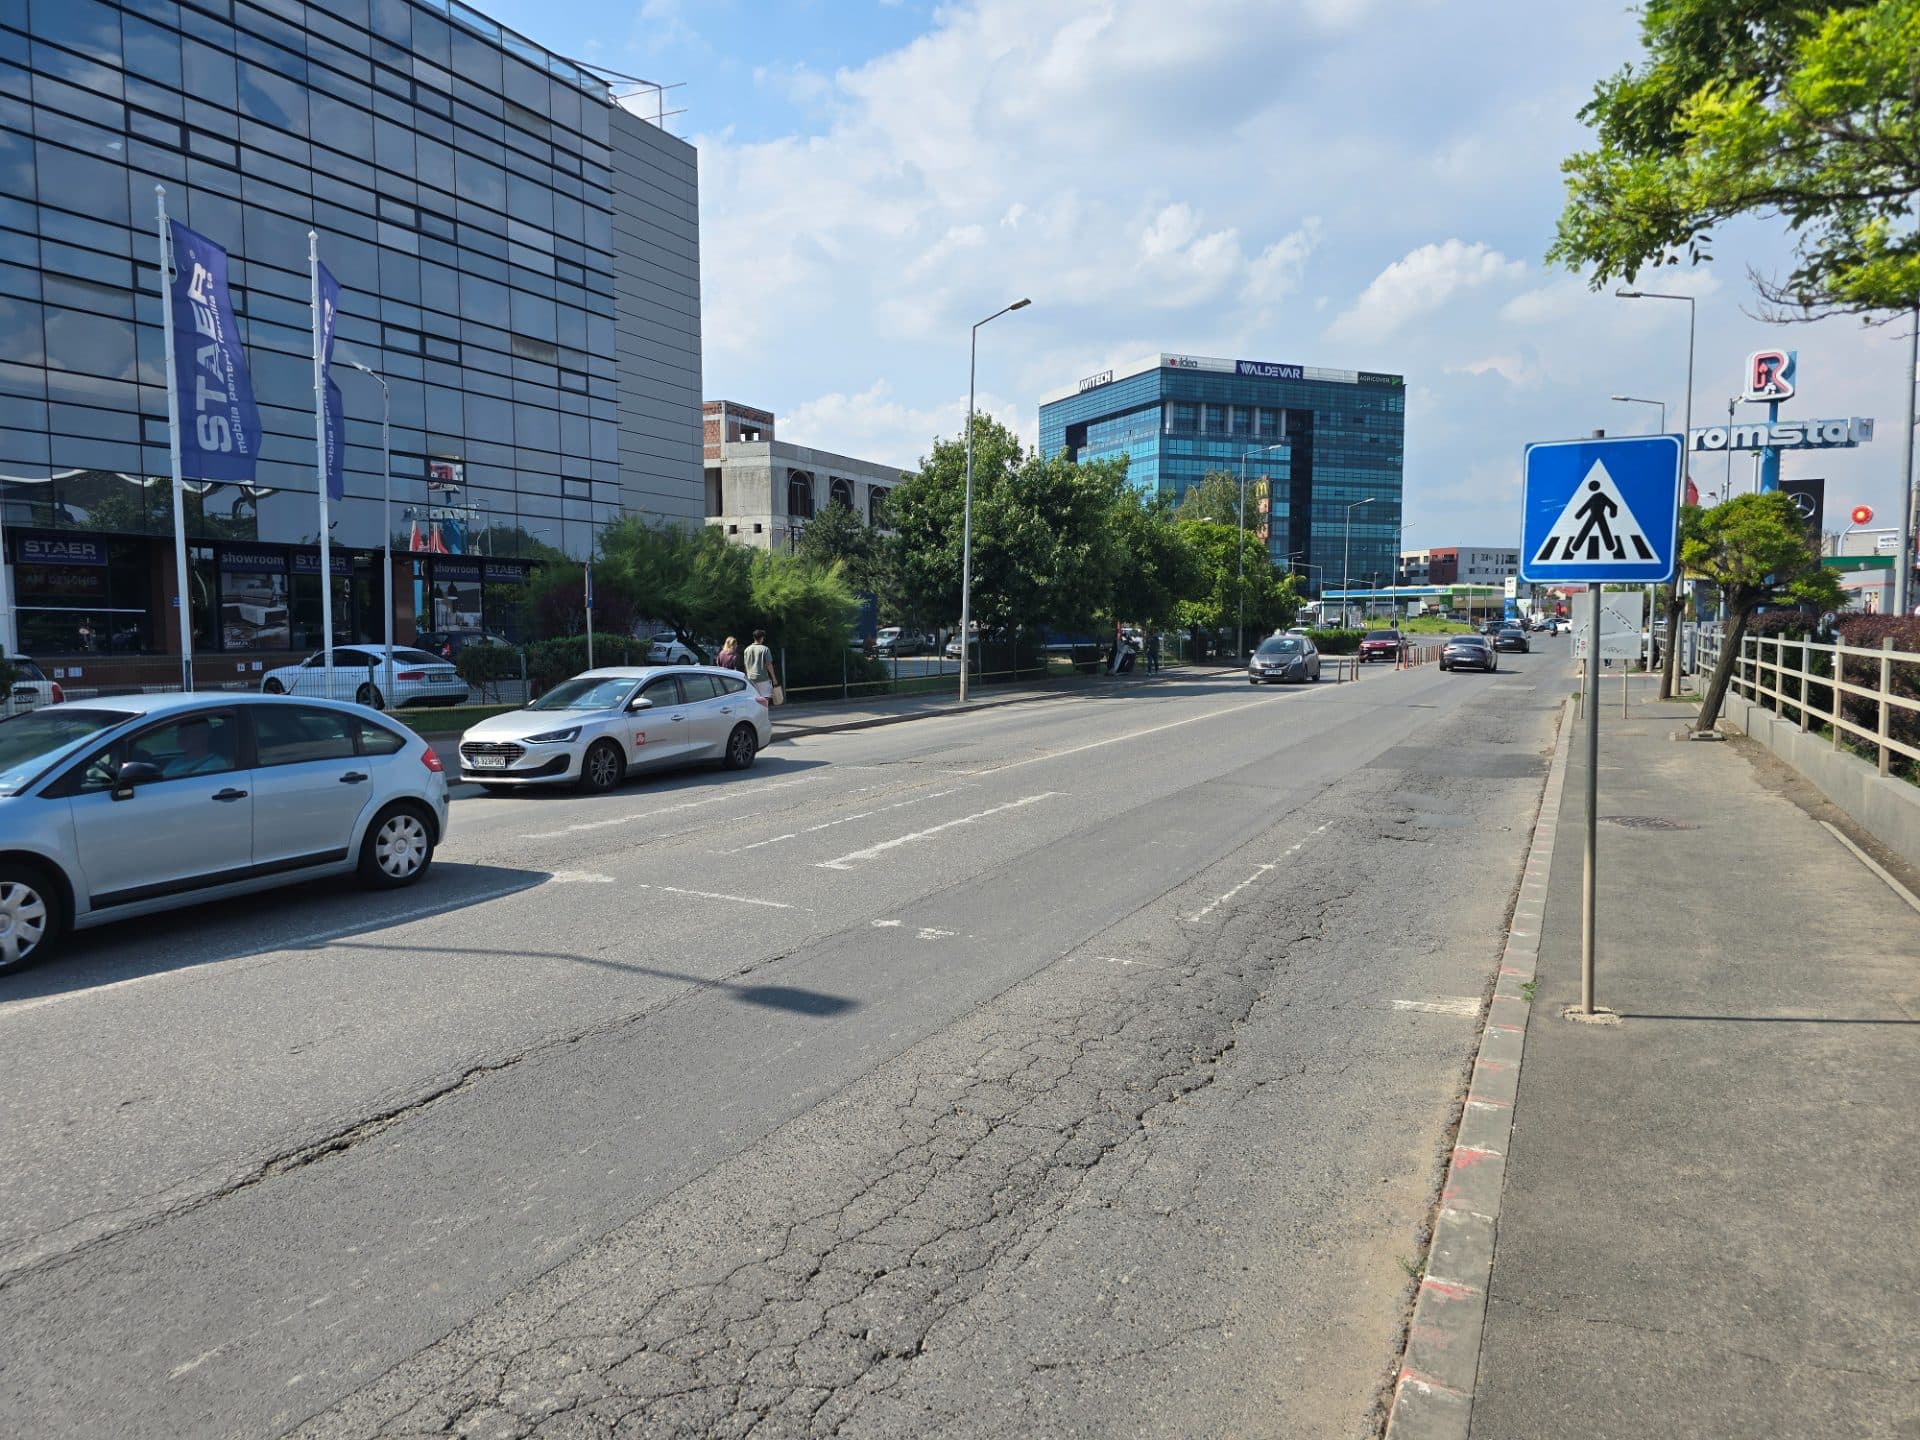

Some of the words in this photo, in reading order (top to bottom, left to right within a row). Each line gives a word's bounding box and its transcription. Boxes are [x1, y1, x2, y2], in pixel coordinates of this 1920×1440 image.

[188, 262, 232, 453] STAER
[1239, 361, 1301, 379] WALDEVAR
[1079, 370, 1113, 393] AVITECH
[1359, 375, 1390, 384] AGRICOVER
[1689, 417, 1864, 451] romstal
[24, 540, 96, 555] STAER
[221, 552, 285, 566] showroom
[433, 563, 480, 575] showroom
[486, 563, 523, 575] STAER
